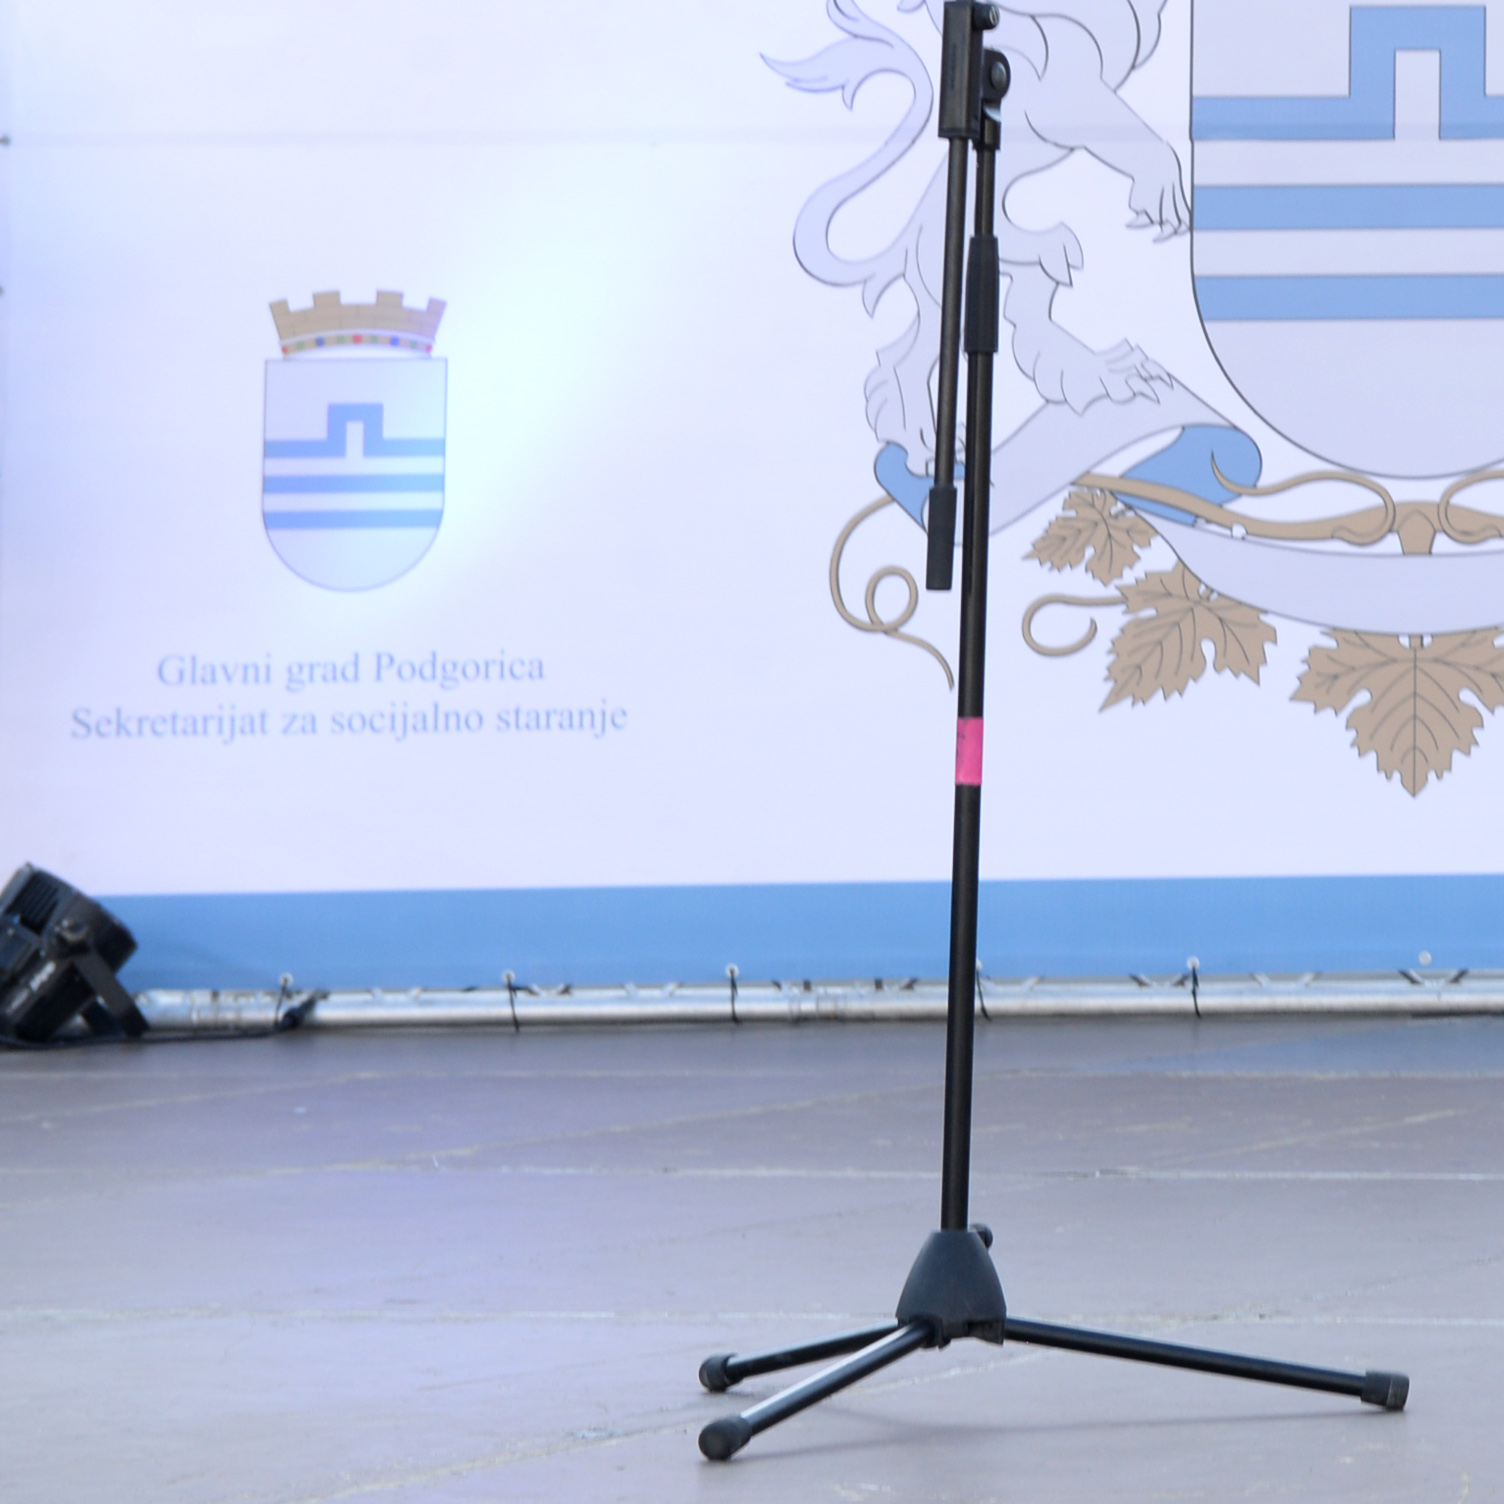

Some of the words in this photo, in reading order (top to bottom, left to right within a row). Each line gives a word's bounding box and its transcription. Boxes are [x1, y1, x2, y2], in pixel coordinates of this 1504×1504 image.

[157, 653, 272, 686] Glavni
[285, 651, 360, 693] grad
[374, 649, 545, 692] Podgorica
[71, 704, 267, 744] Sekretarijat
[281, 712, 317, 736] za
[330, 701, 484, 742] socijalno
[497, 699, 628, 739] staranje
